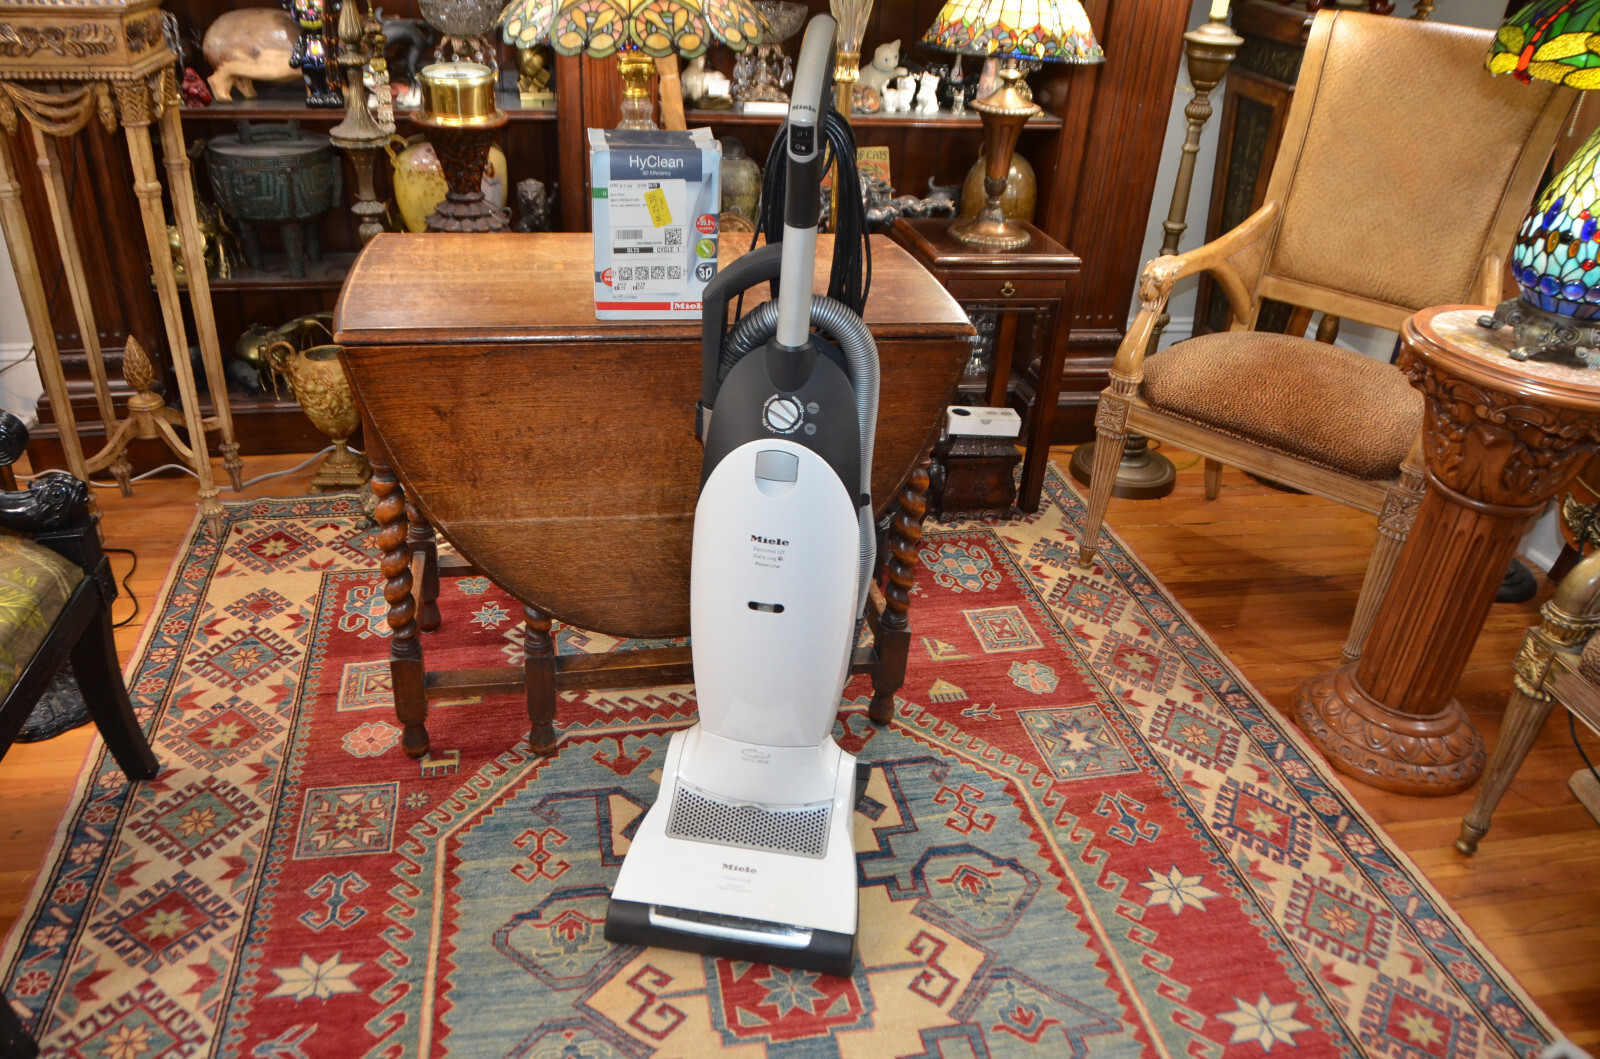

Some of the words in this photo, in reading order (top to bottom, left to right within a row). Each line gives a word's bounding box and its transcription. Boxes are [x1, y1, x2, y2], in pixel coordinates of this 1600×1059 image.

[792, 103, 817, 112] Miele
[866, 150, 888, 160] CATS
[629, 155, 684, 170] HyClean
[699, 266, 713, 280] 3D
[674, 302, 702, 310] Miel
[750, 534, 790, 546] Miele
[722, 863, 758, 874] Miele
